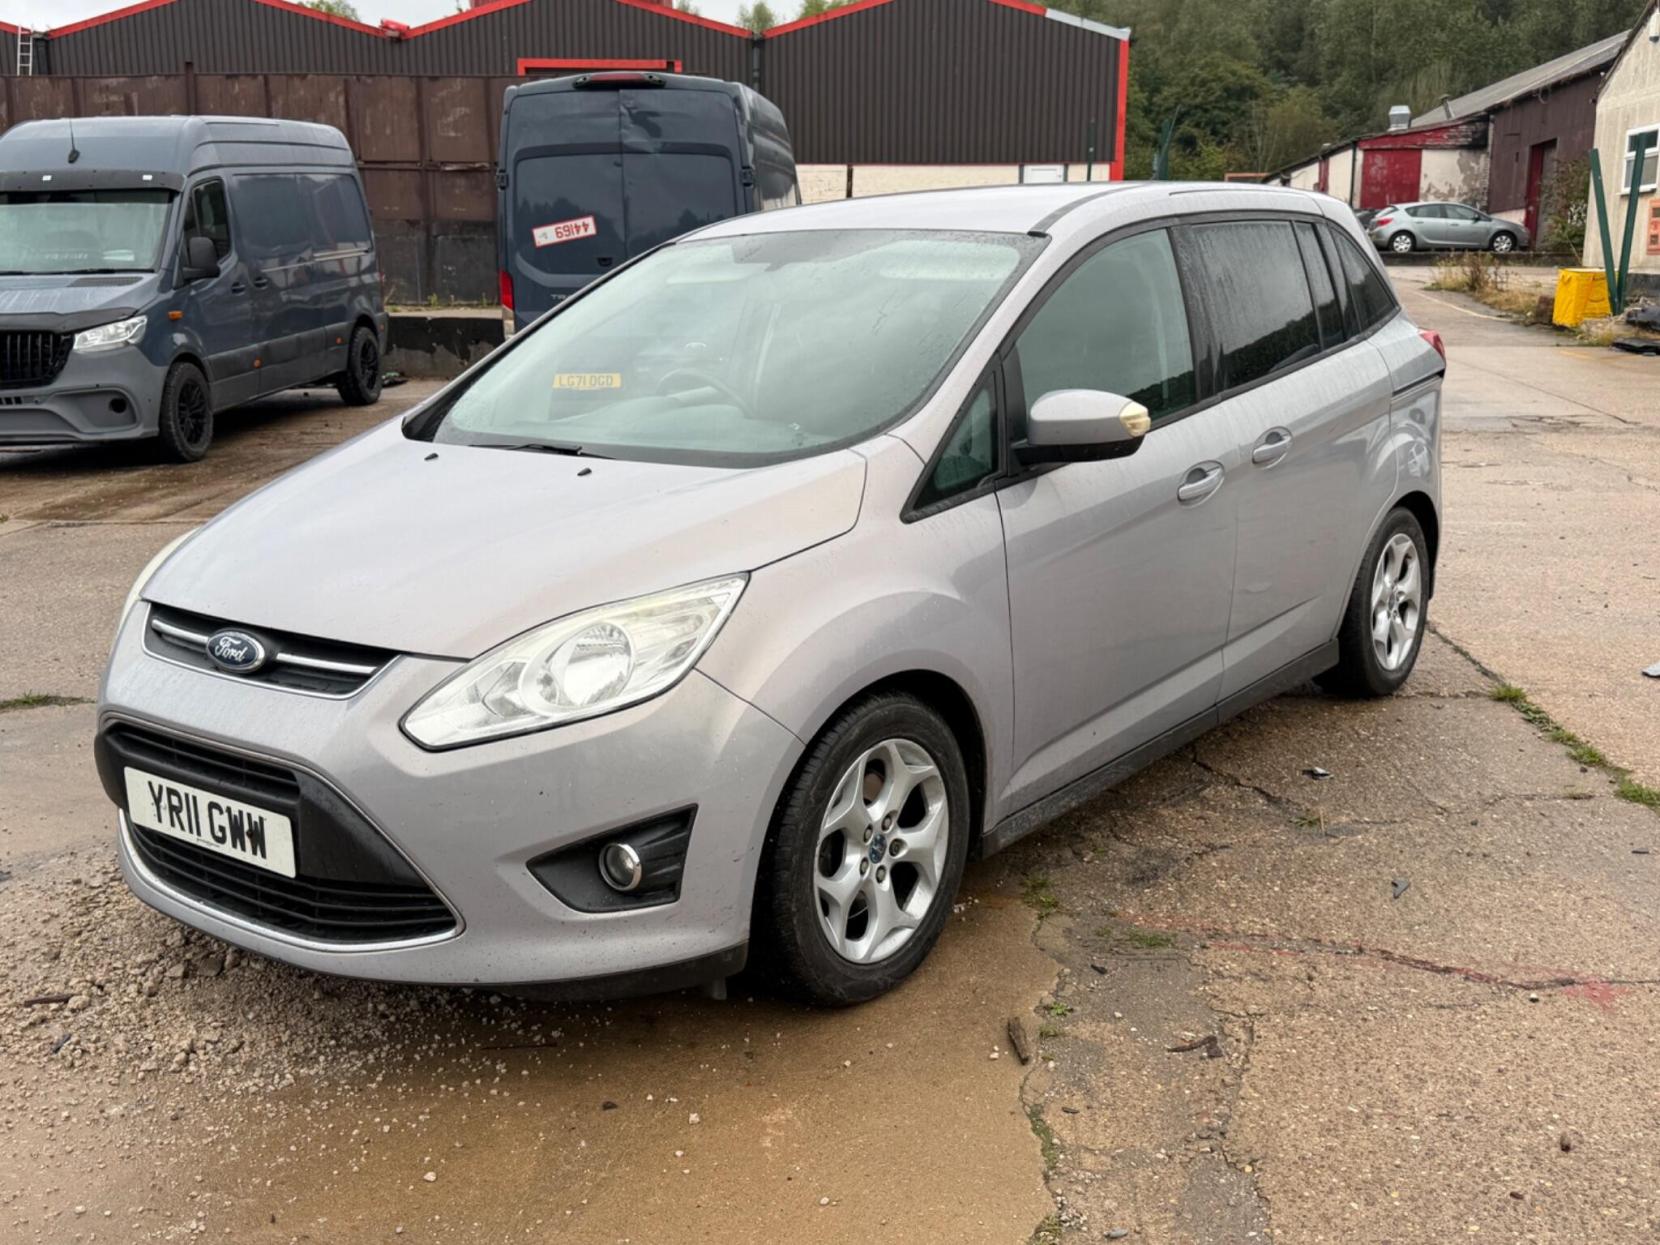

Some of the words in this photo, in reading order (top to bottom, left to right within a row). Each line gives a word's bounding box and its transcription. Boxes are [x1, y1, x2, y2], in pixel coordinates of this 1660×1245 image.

[214, 636, 248, 662] Ford
[147, 780, 201, 837] YR11
[207, 801, 267, 860] GWW
